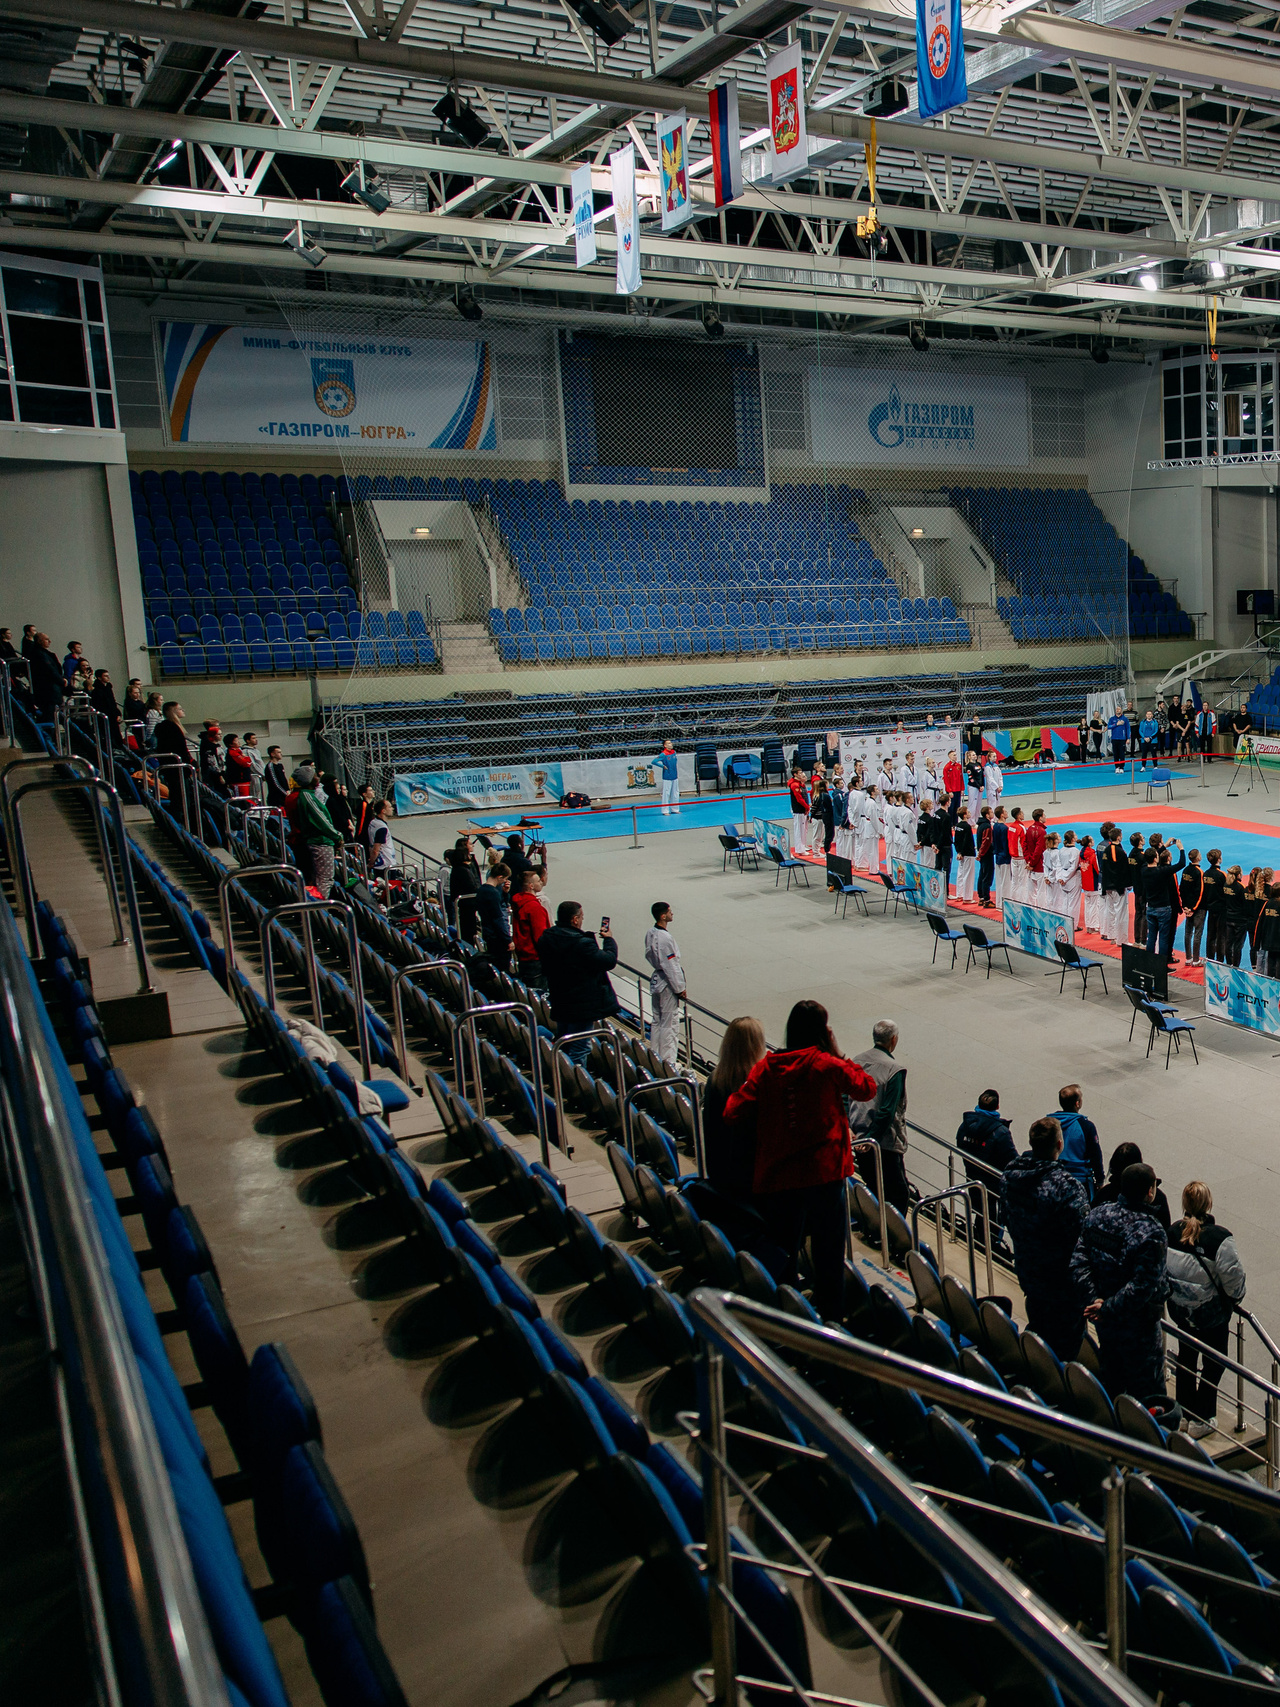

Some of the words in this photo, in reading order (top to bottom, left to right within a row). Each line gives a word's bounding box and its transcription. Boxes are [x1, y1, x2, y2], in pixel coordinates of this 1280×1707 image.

[904, 403, 975, 426] ГАЗПРОМ
[441, 785, 484, 795] ЧЕМПИОН
[487, 782, 521, 792] РОССИИ
